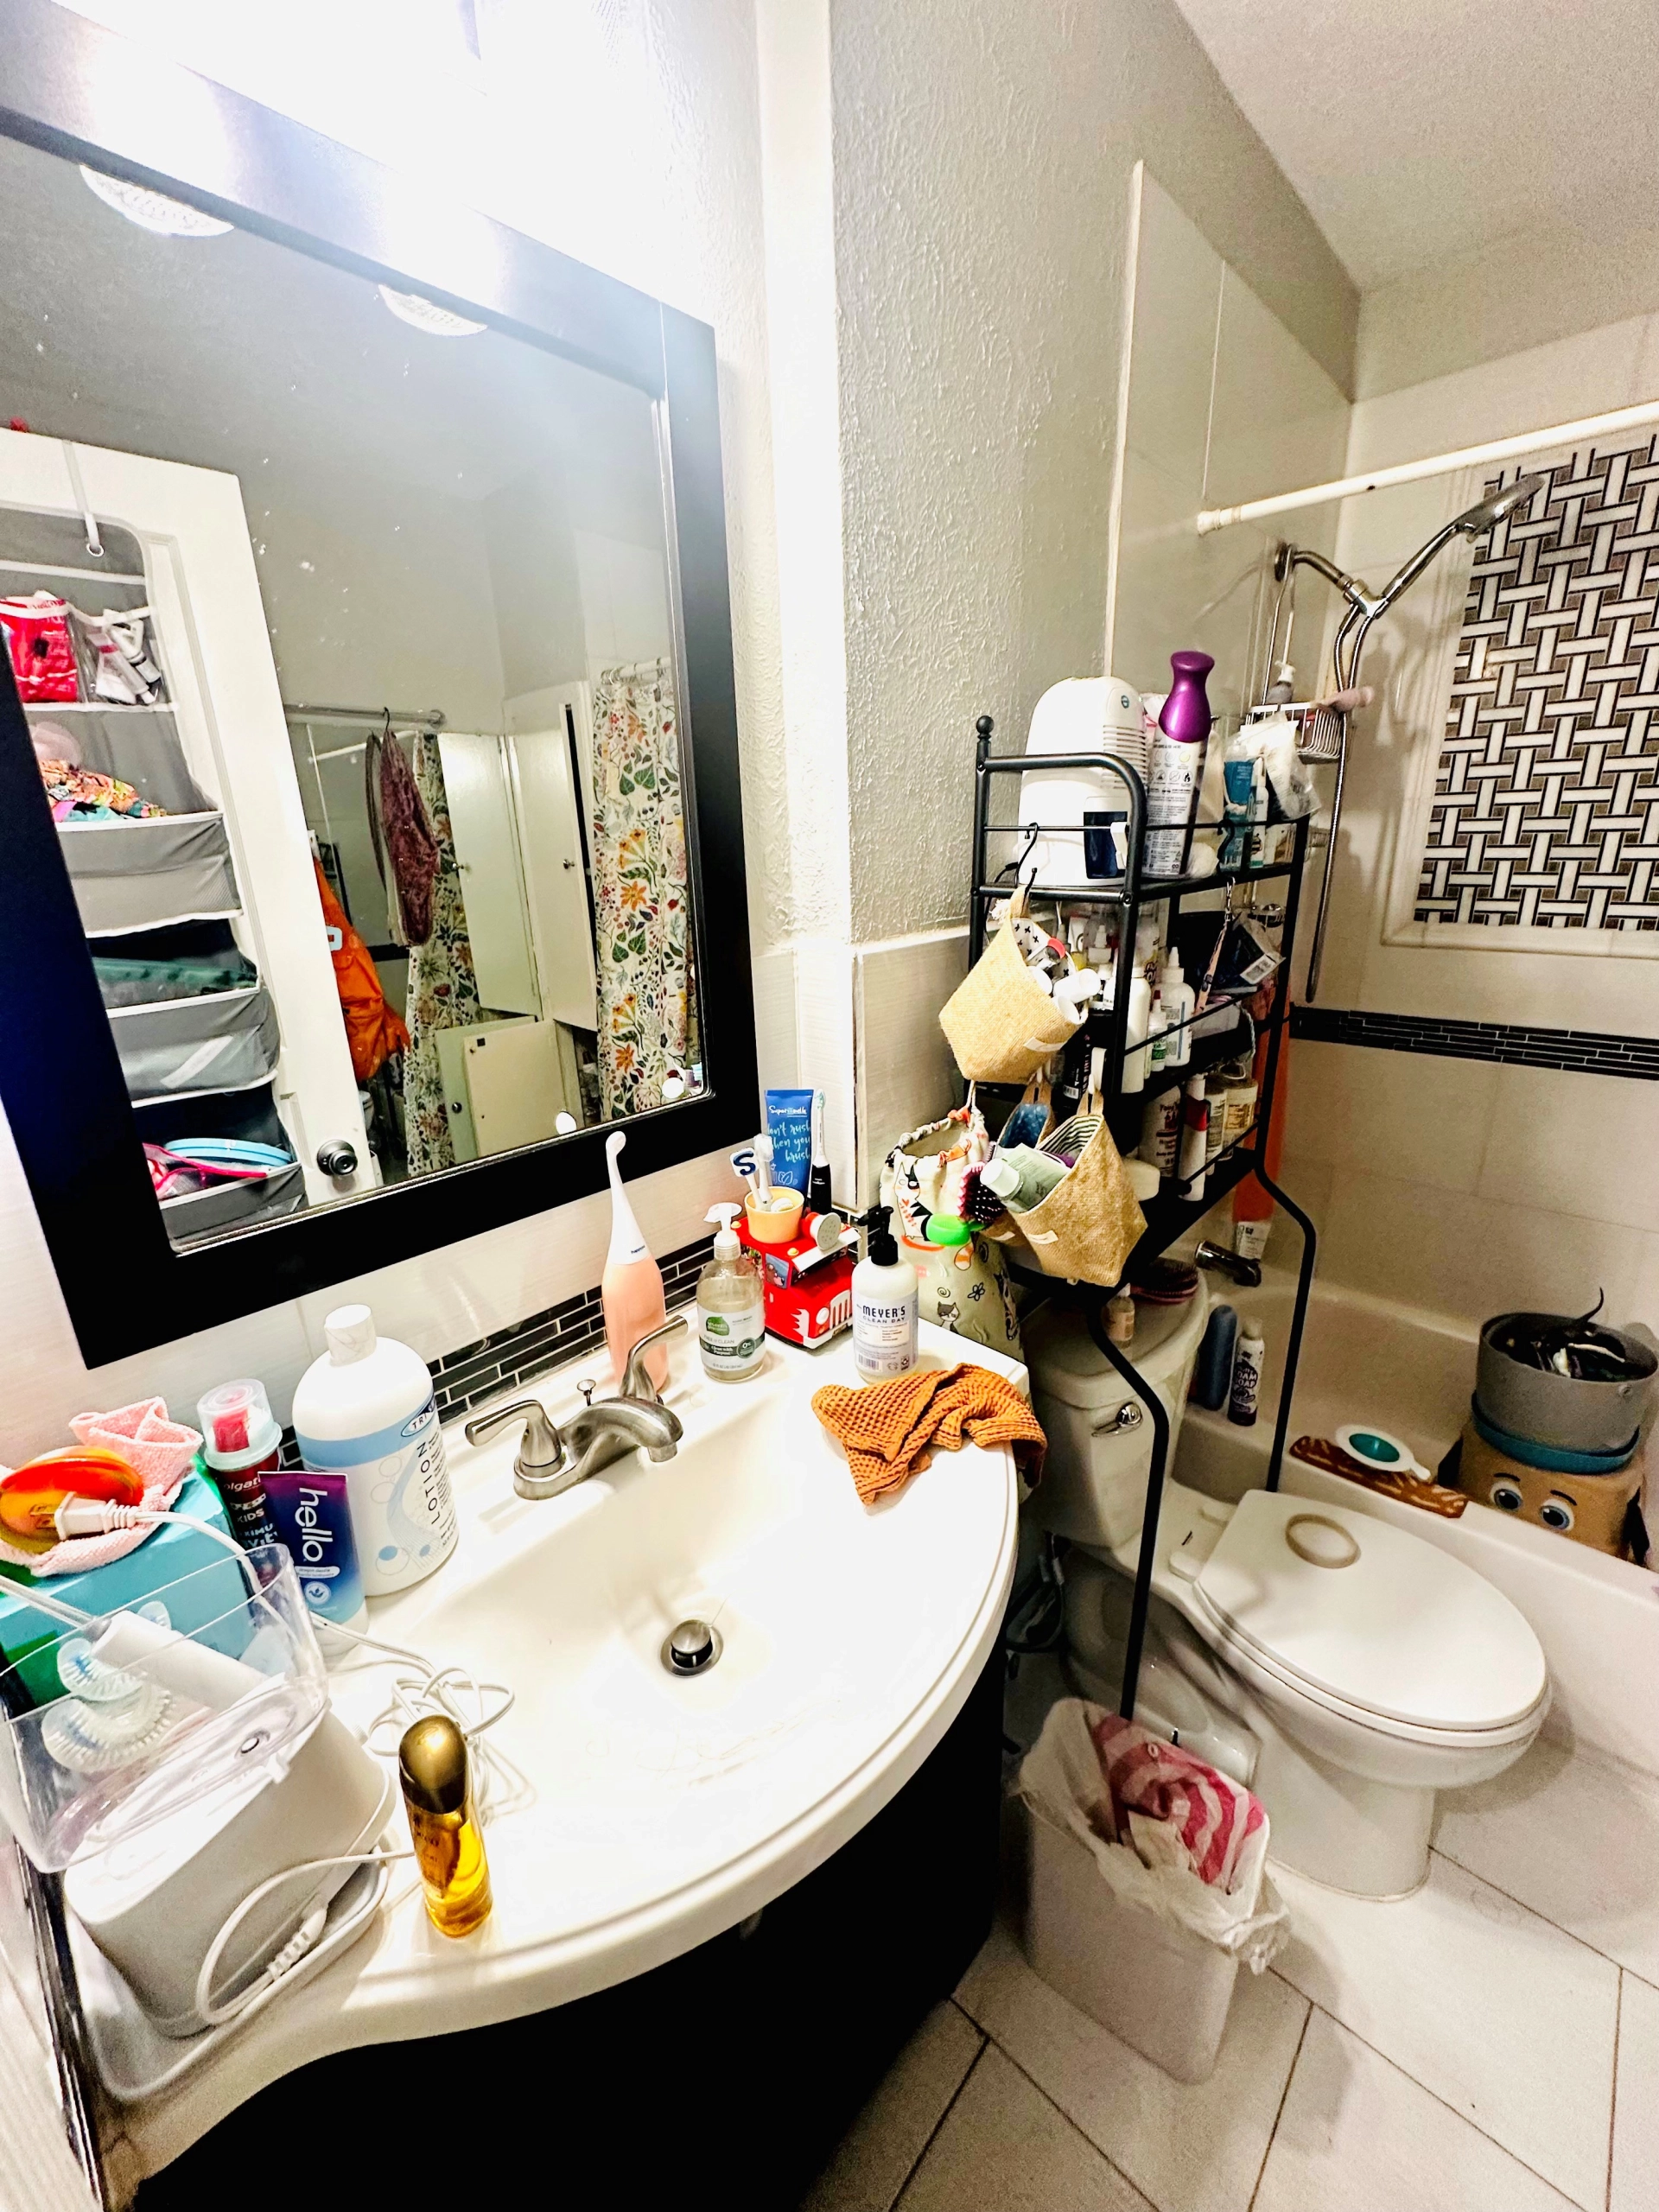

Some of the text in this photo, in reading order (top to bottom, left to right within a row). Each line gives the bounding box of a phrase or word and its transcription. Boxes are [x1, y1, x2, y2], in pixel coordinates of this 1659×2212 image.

[733, 1150, 756, 1176] S
[862, 1305, 906, 1319] MEYER'S
[224, 1477, 261, 1492] olgat
[416, 1442, 441, 1525] LOTION
[295, 1487, 334, 1562] hello
